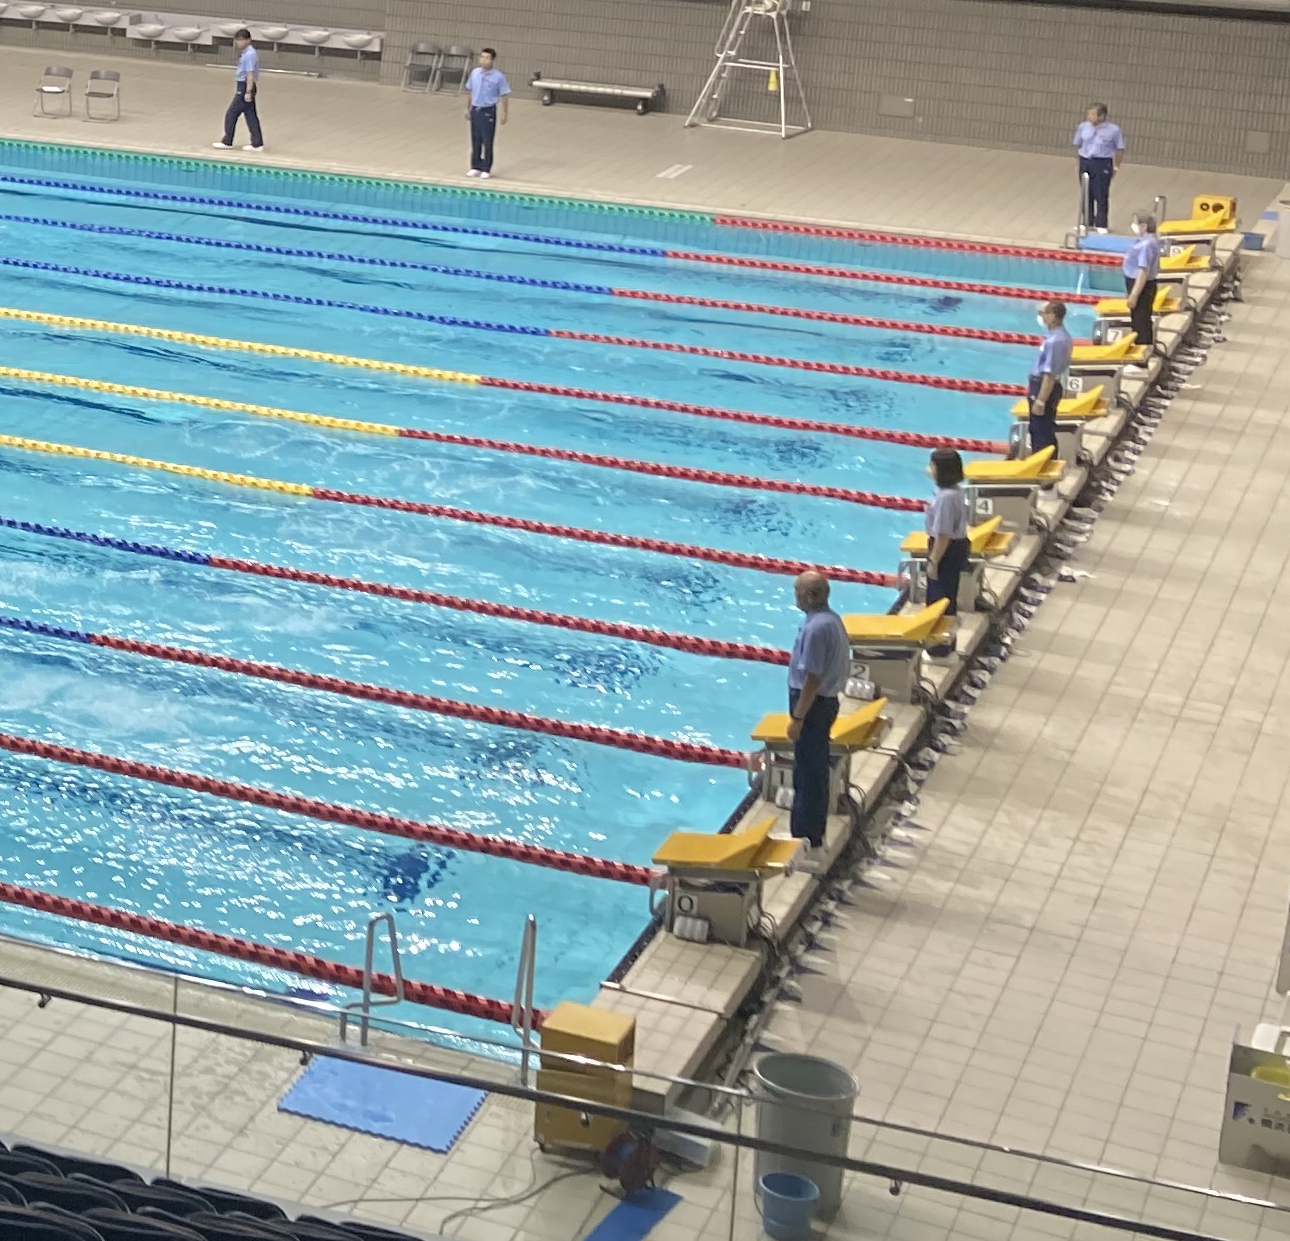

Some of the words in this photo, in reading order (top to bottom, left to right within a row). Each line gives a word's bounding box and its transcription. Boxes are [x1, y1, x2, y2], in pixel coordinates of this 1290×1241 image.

[1109, 329, 1121, 341] 7
[1070, 378, 1080, 390] 6
[977, 499, 989, 513] 4
[852, 664, 866, 678] 2
